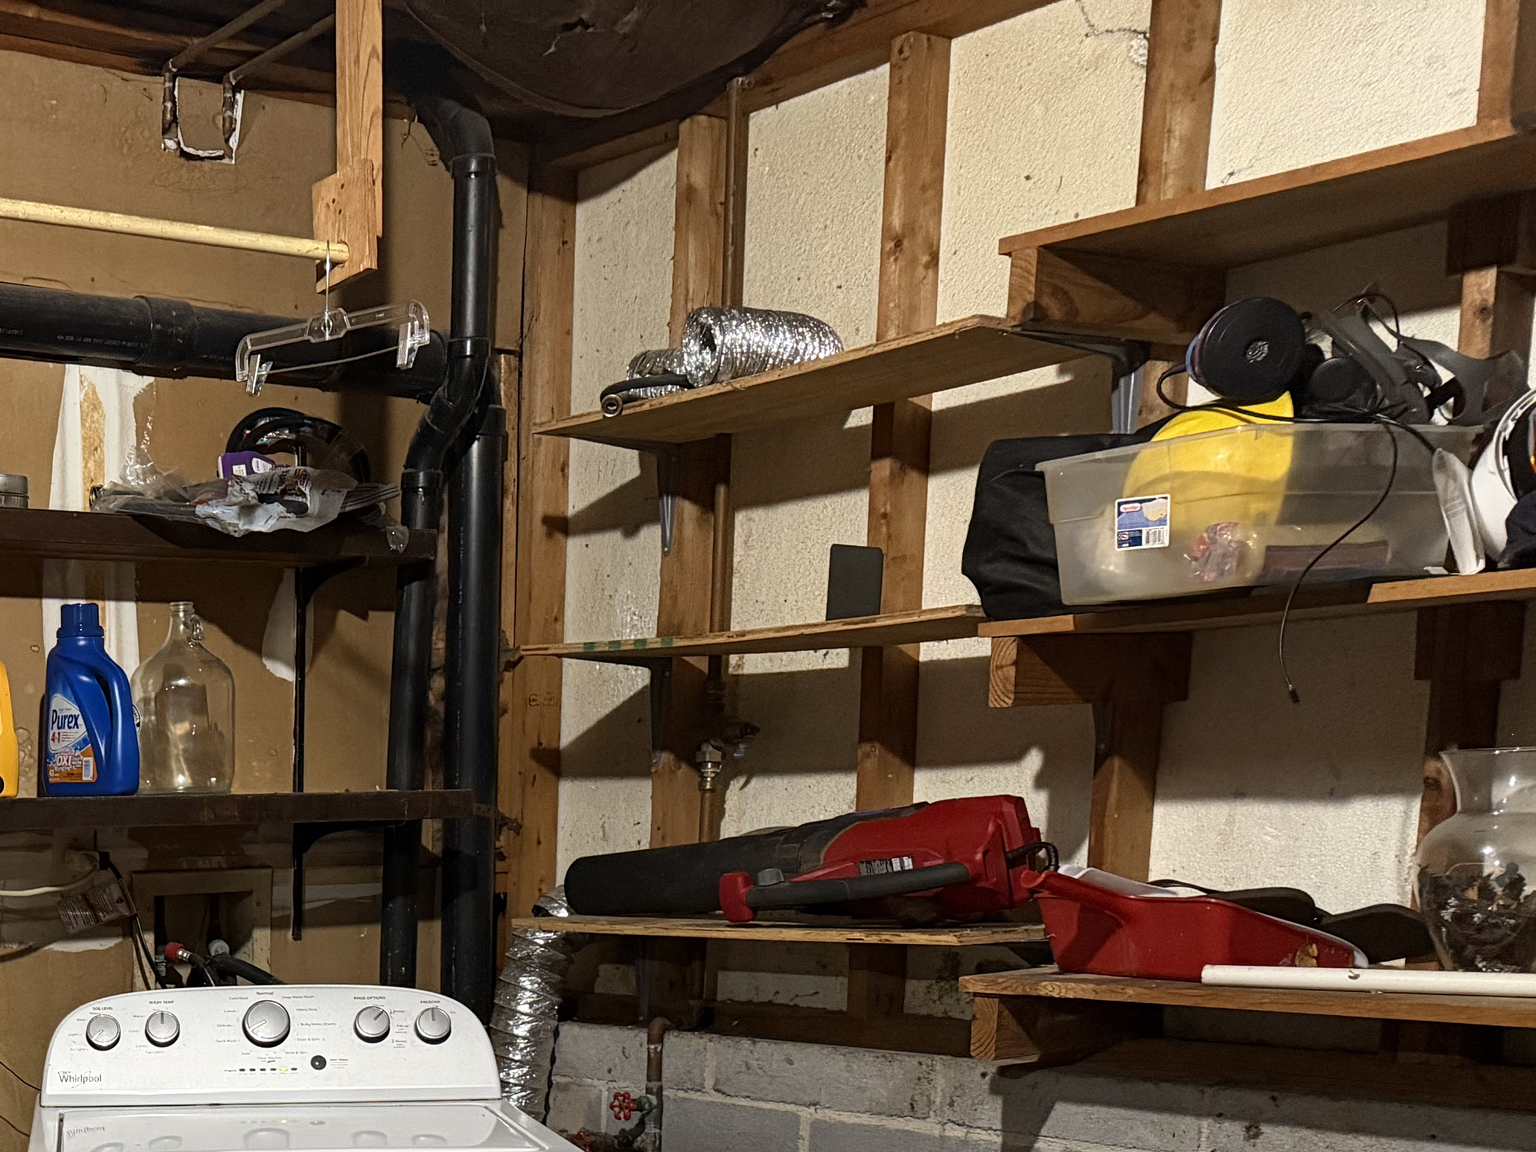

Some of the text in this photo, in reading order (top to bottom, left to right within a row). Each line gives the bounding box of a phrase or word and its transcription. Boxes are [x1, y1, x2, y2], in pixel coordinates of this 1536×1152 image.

[51, 709, 80, 730] Purex
[56, 755, 72, 766] OXI
[58, 1073, 102, 1084] Whirlpool
